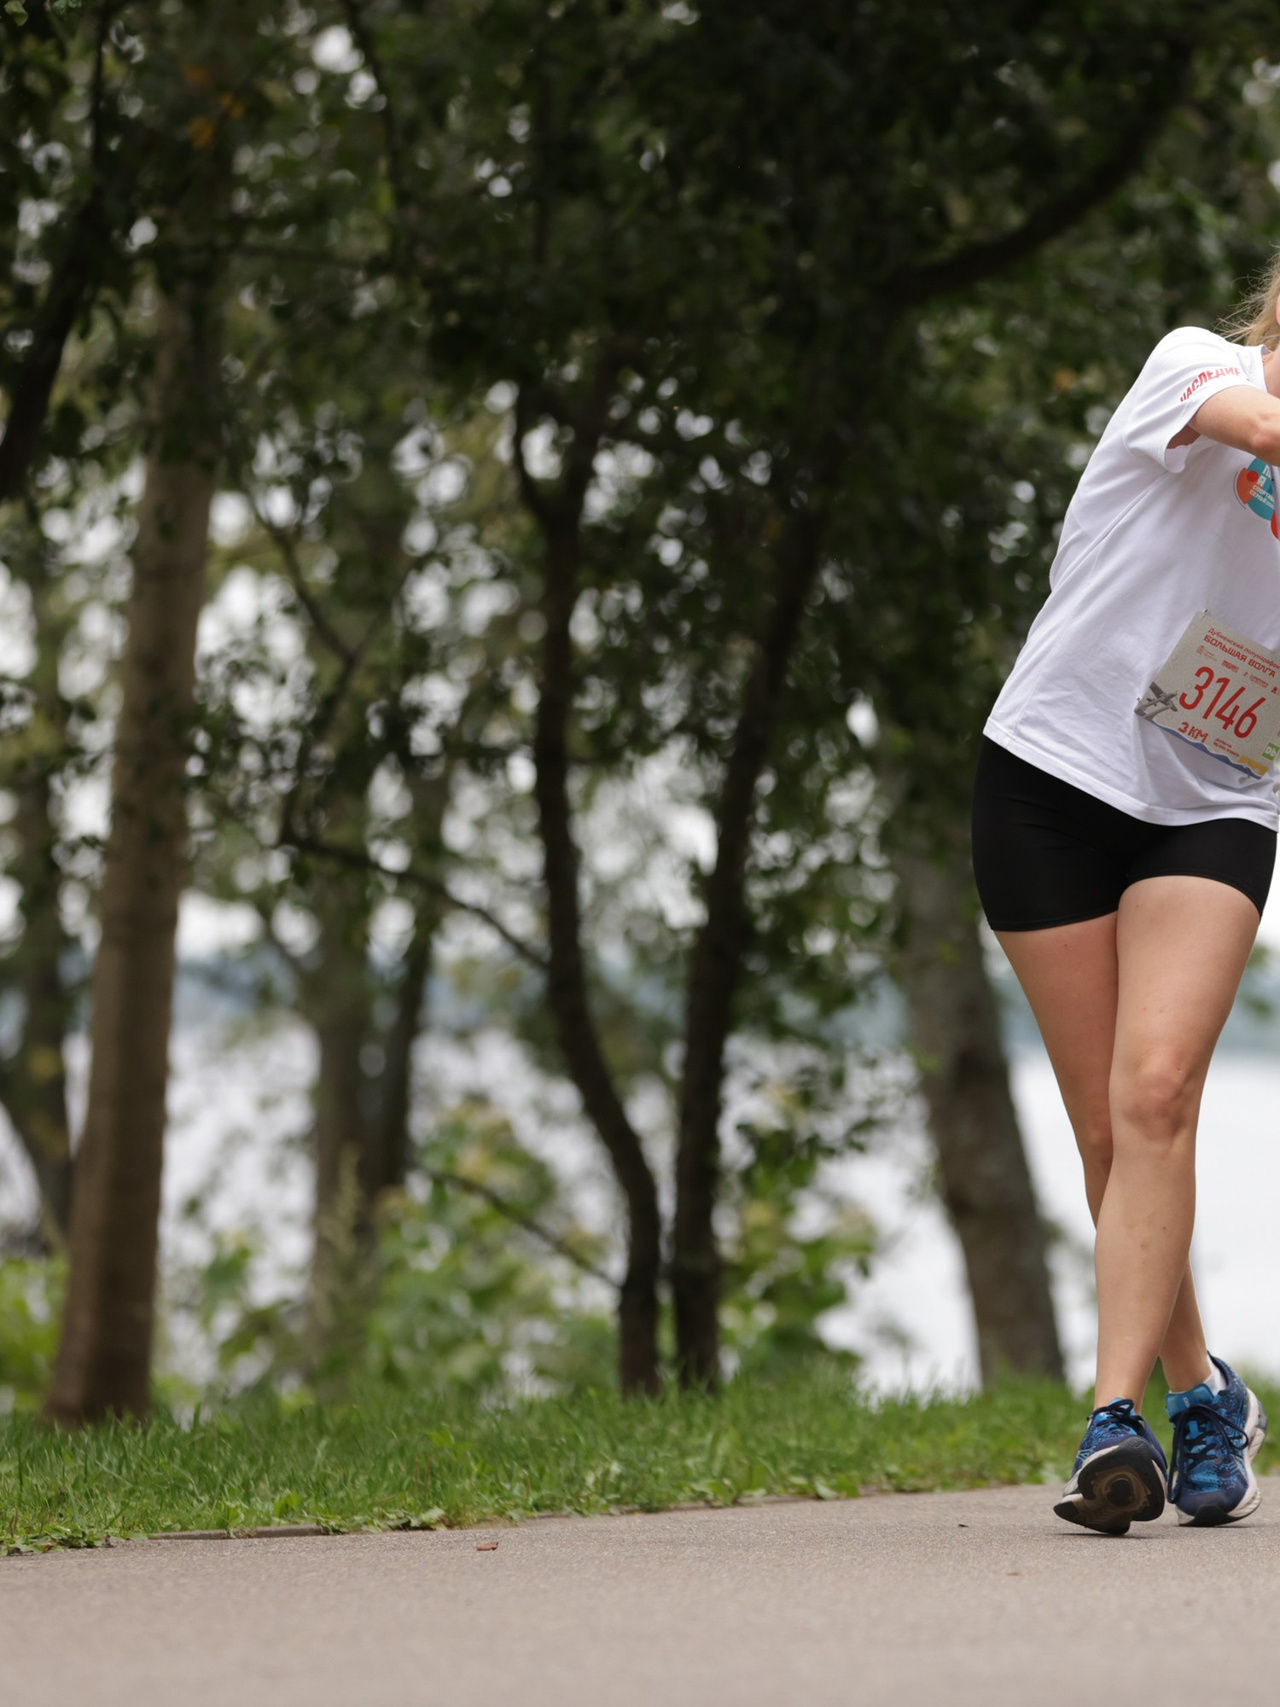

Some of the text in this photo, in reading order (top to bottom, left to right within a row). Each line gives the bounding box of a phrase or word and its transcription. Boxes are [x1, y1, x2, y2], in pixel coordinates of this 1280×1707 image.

[1203, 634, 1247, 662] БОЛЬШАЯ
[1247, 659, 1276, 679] ВОЛГА
[1179, 666, 1266, 738] 3146
[1178, 721, 1190, 734] 3
[1187, 726, 1209, 743] КМ
